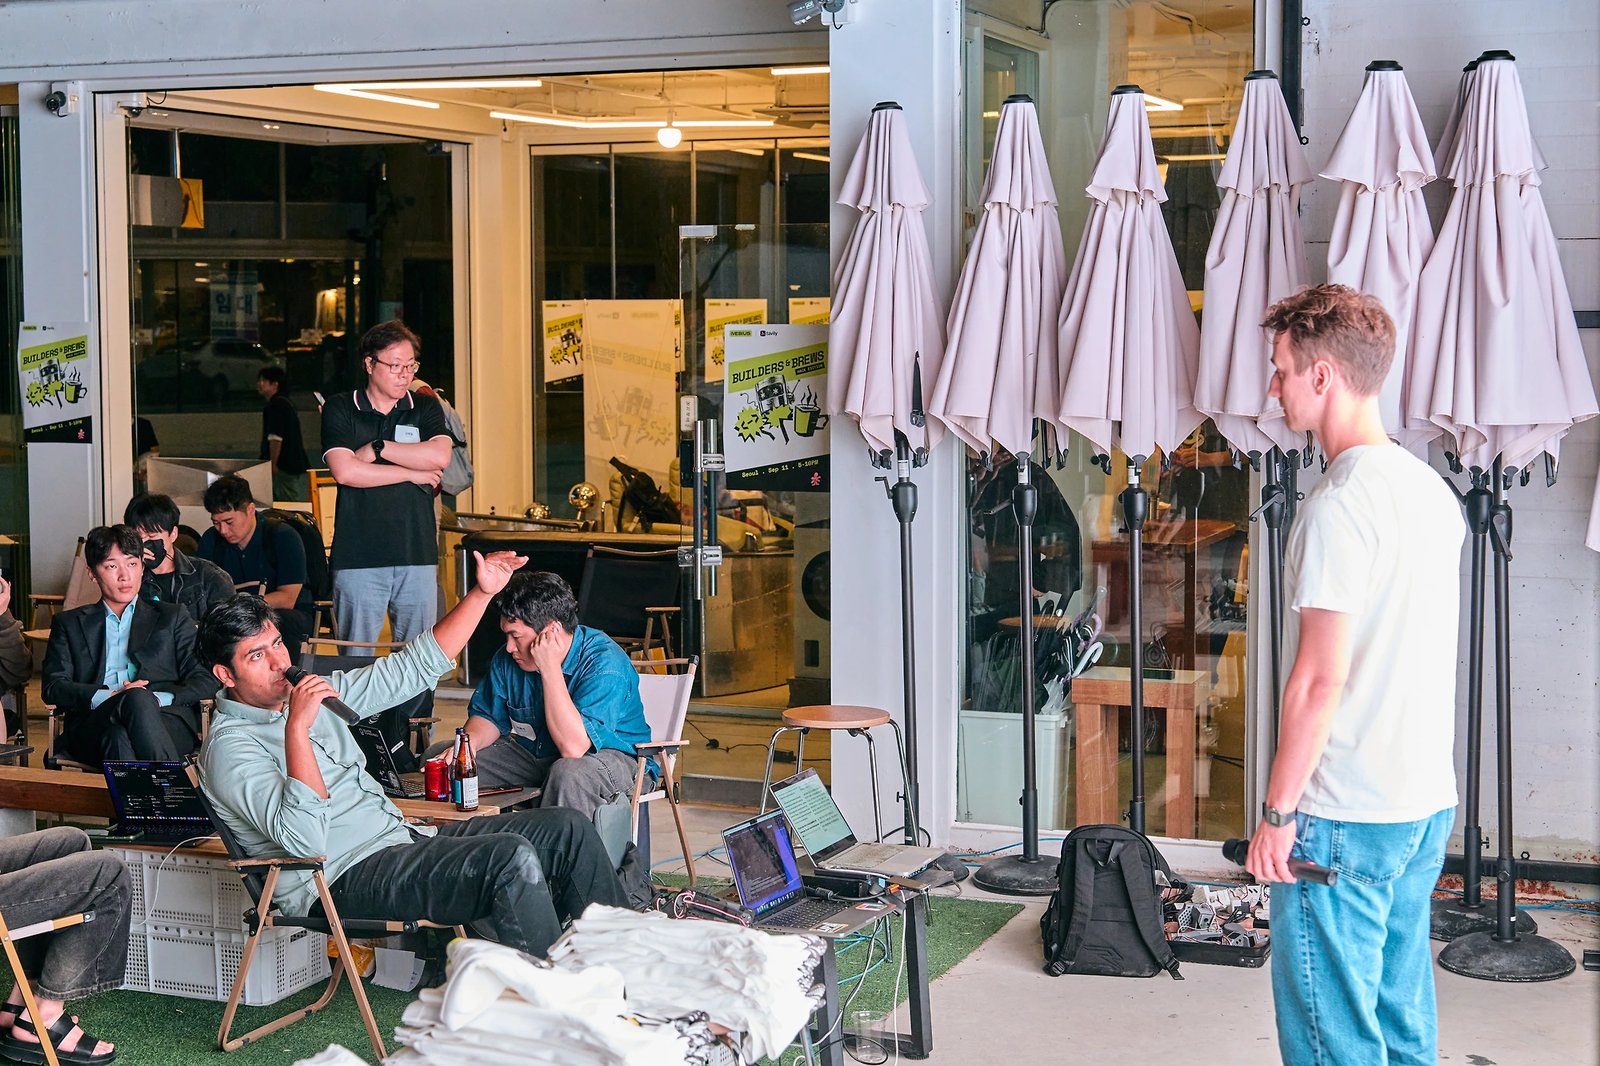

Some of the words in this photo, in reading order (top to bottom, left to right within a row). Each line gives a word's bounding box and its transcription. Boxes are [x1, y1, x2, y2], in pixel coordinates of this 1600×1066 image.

[23, 348, 59, 365] BUILDERS
[63, 340, 86, 354] BREWS
[732, 360, 785, 384] BUILDERS
[785, 359, 791, 367] &
[791, 350, 825, 368] BREWS
[742, 470, 759, 478] Seoul
